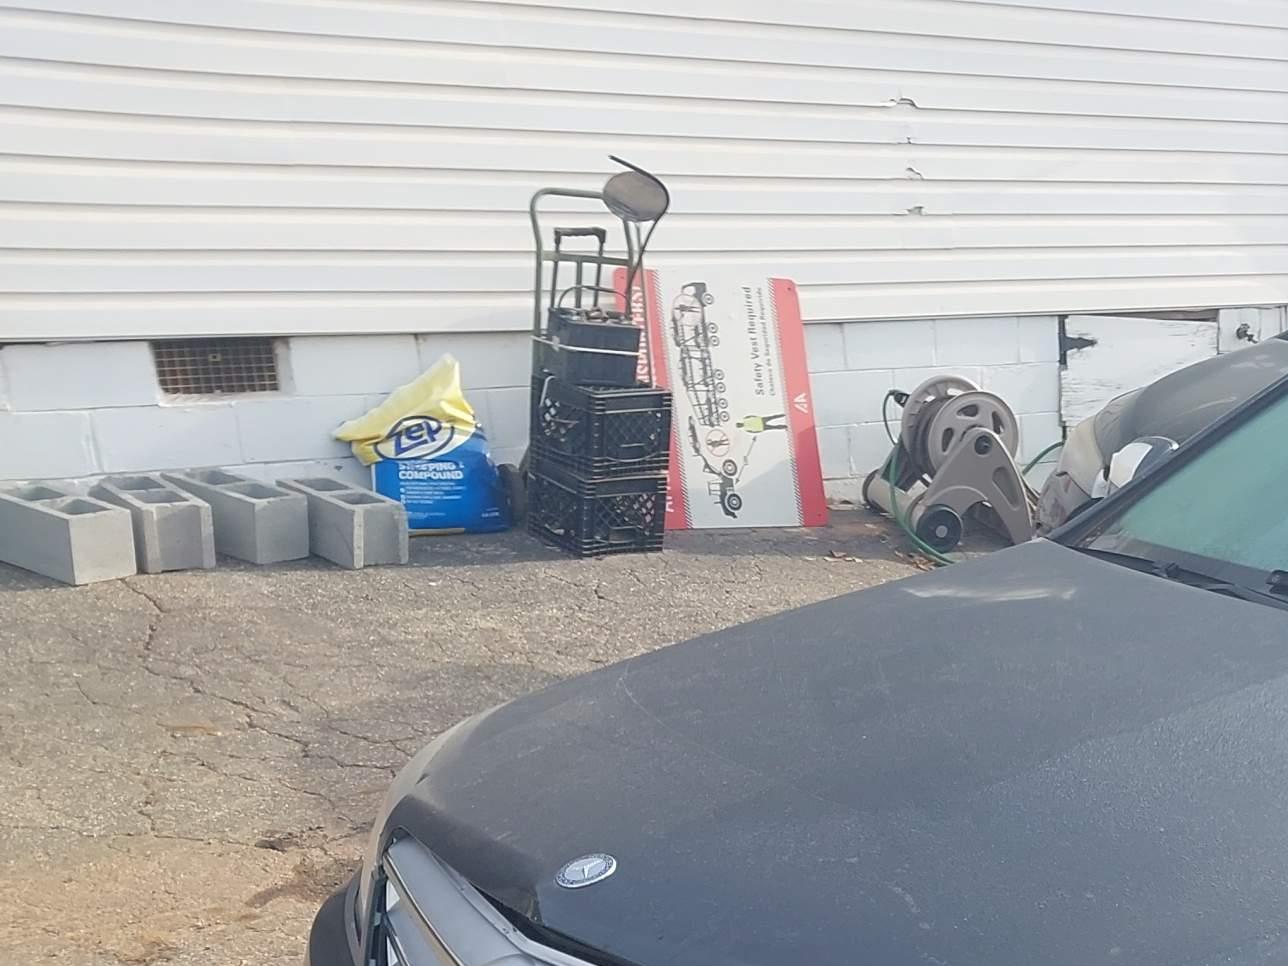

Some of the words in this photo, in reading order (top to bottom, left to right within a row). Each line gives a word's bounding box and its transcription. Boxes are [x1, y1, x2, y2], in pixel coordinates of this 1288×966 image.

[741, 286, 757, 335] Required
[749, 337, 760, 360] Vest
[753, 362, 765, 396] Safety
[399, 471, 464, 480] COMPOUND
